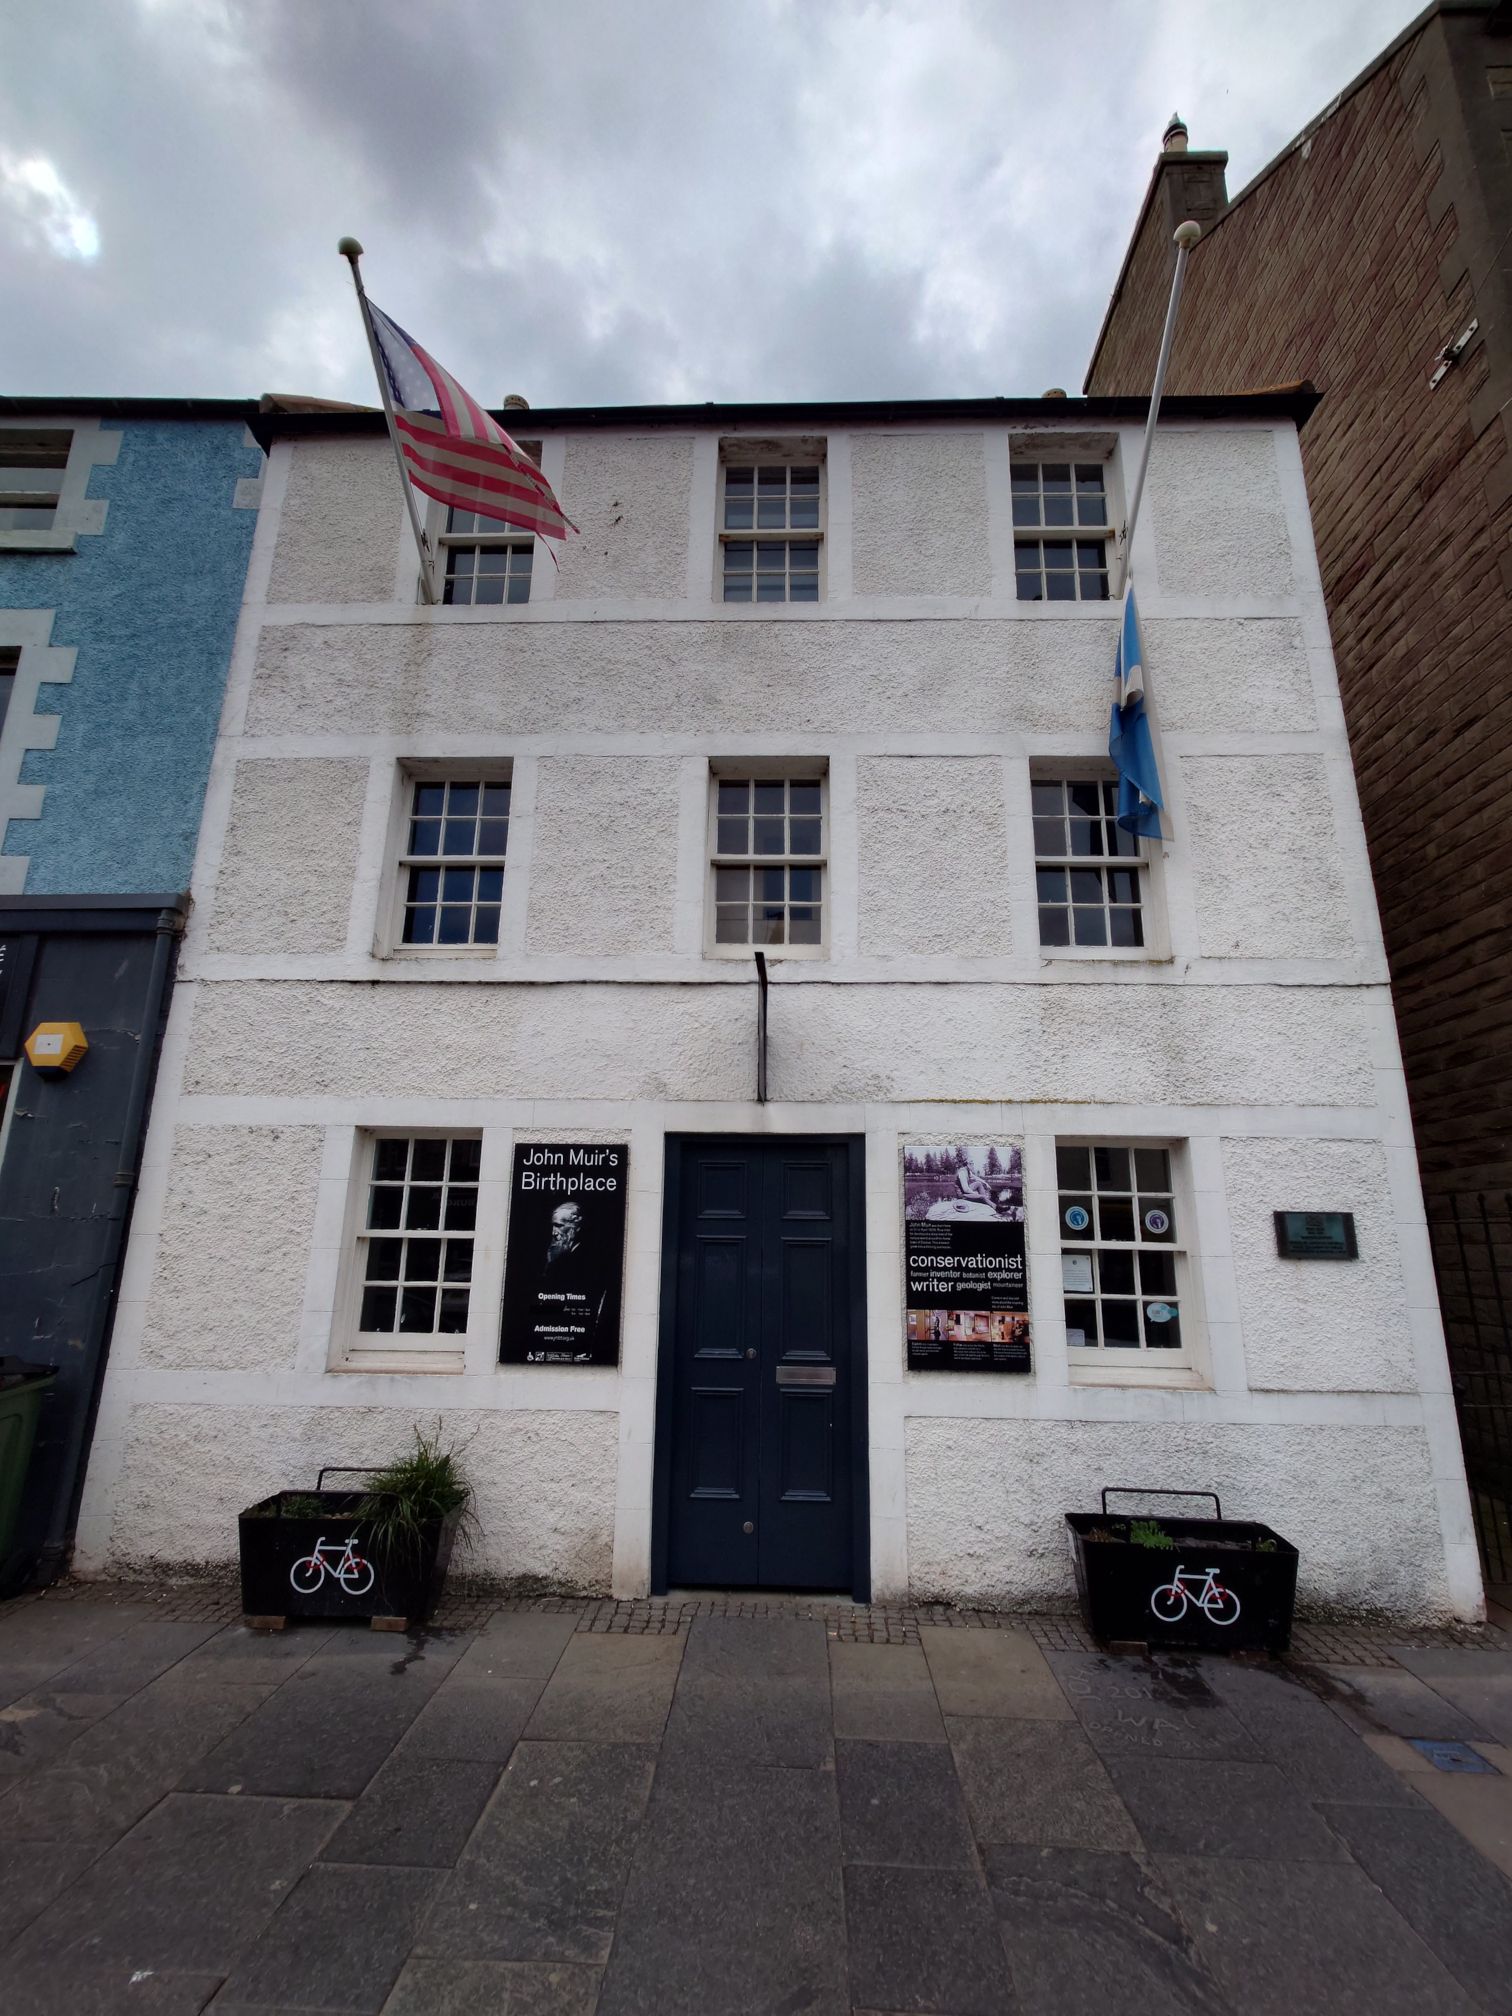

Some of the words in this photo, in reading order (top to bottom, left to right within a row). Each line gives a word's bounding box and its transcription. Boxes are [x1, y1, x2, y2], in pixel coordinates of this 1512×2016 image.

[523, 1148, 564, 1165] John
[569, 1148, 619, 1166] Muir's
[521, 1171, 617, 1195] Birthplace
[909, 1253, 1022, 1269] conservationist
[930, 1269, 961, 1279] inventor
[962, 1271, 986, 1279] botanist
[987, 1269, 1022, 1280] explorer
[910, 1278, 954, 1292] writer
[956, 1280, 991, 1292] geologist
[538, 1292, 565, 1301] Opening
[566, 1293, 586, 1301] Times
[534, 1325, 569, 1333] Admission
[570, 1325, 586, 1333] Free
